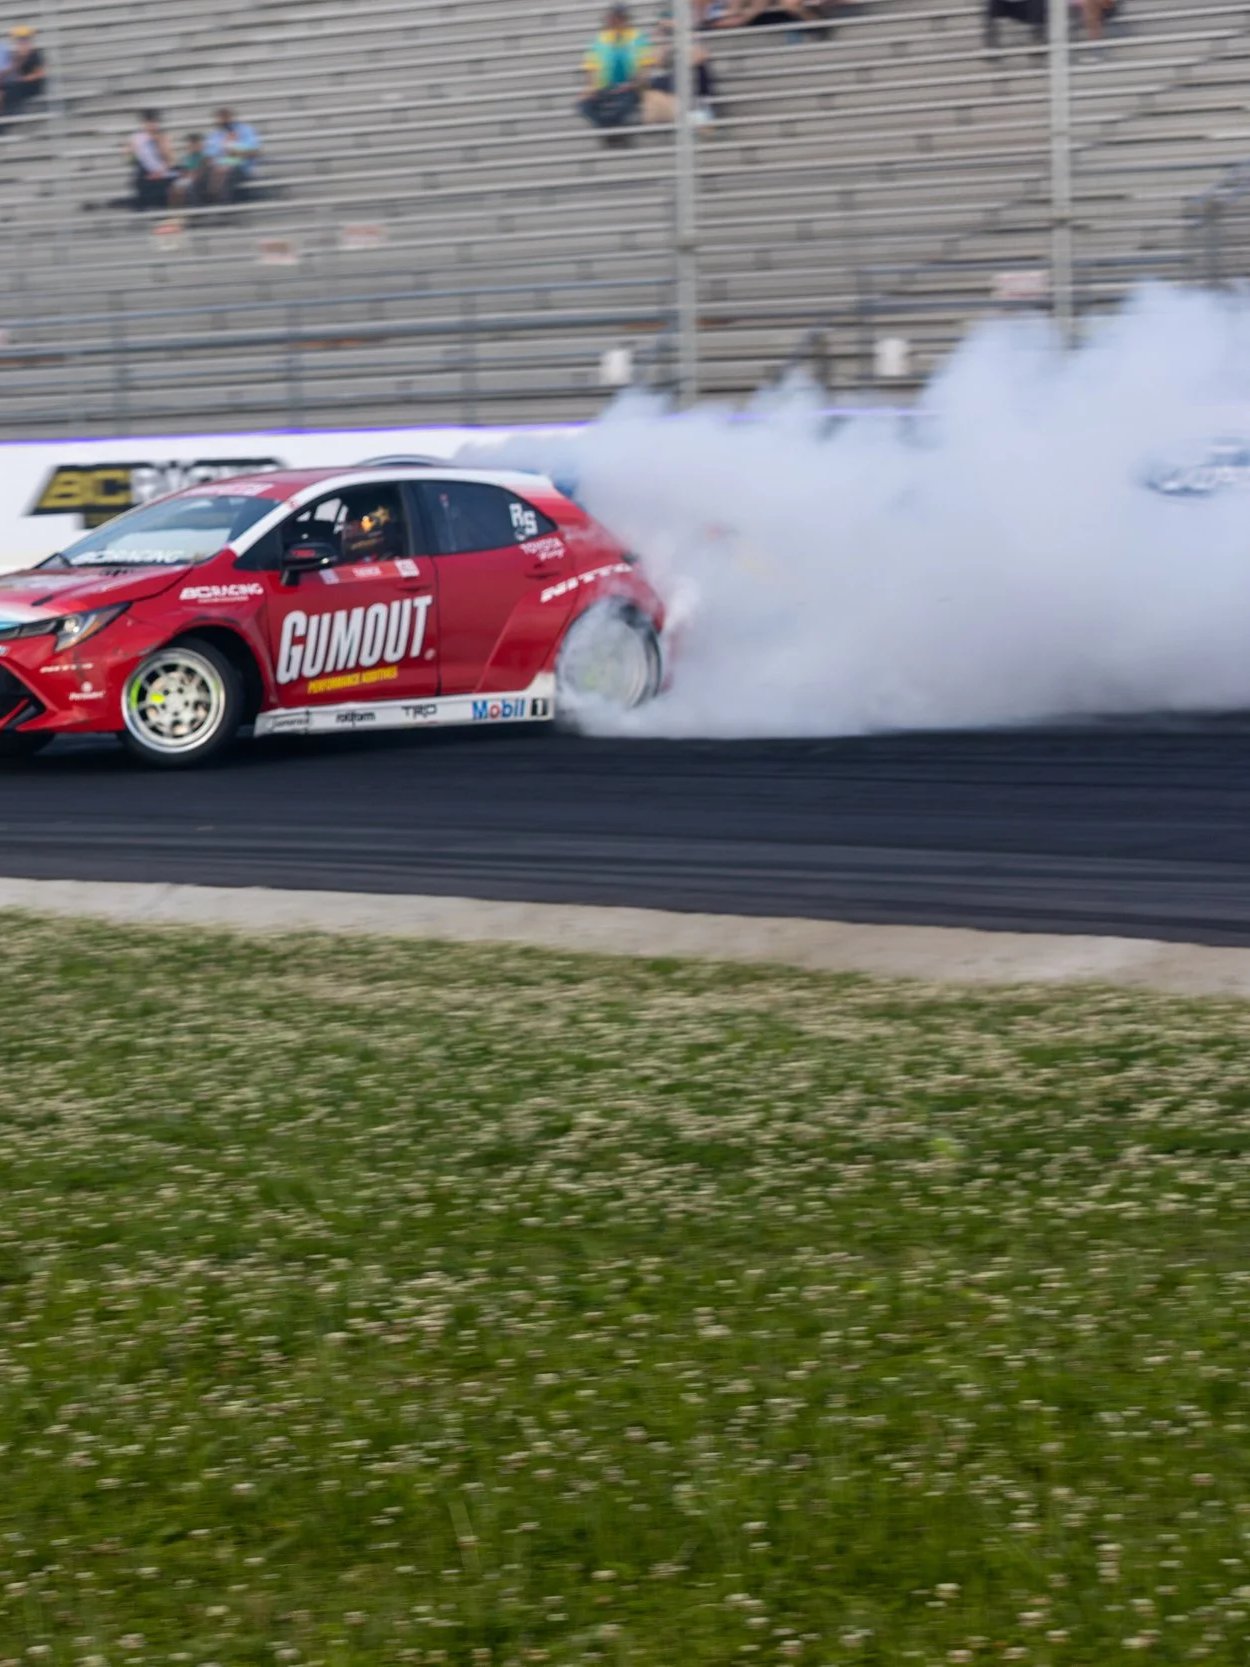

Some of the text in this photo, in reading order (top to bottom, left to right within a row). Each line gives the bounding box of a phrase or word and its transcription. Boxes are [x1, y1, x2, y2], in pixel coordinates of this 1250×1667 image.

[276, 595, 432, 685] GUMOUT
[472, 697, 546, 720] Mobil 1
